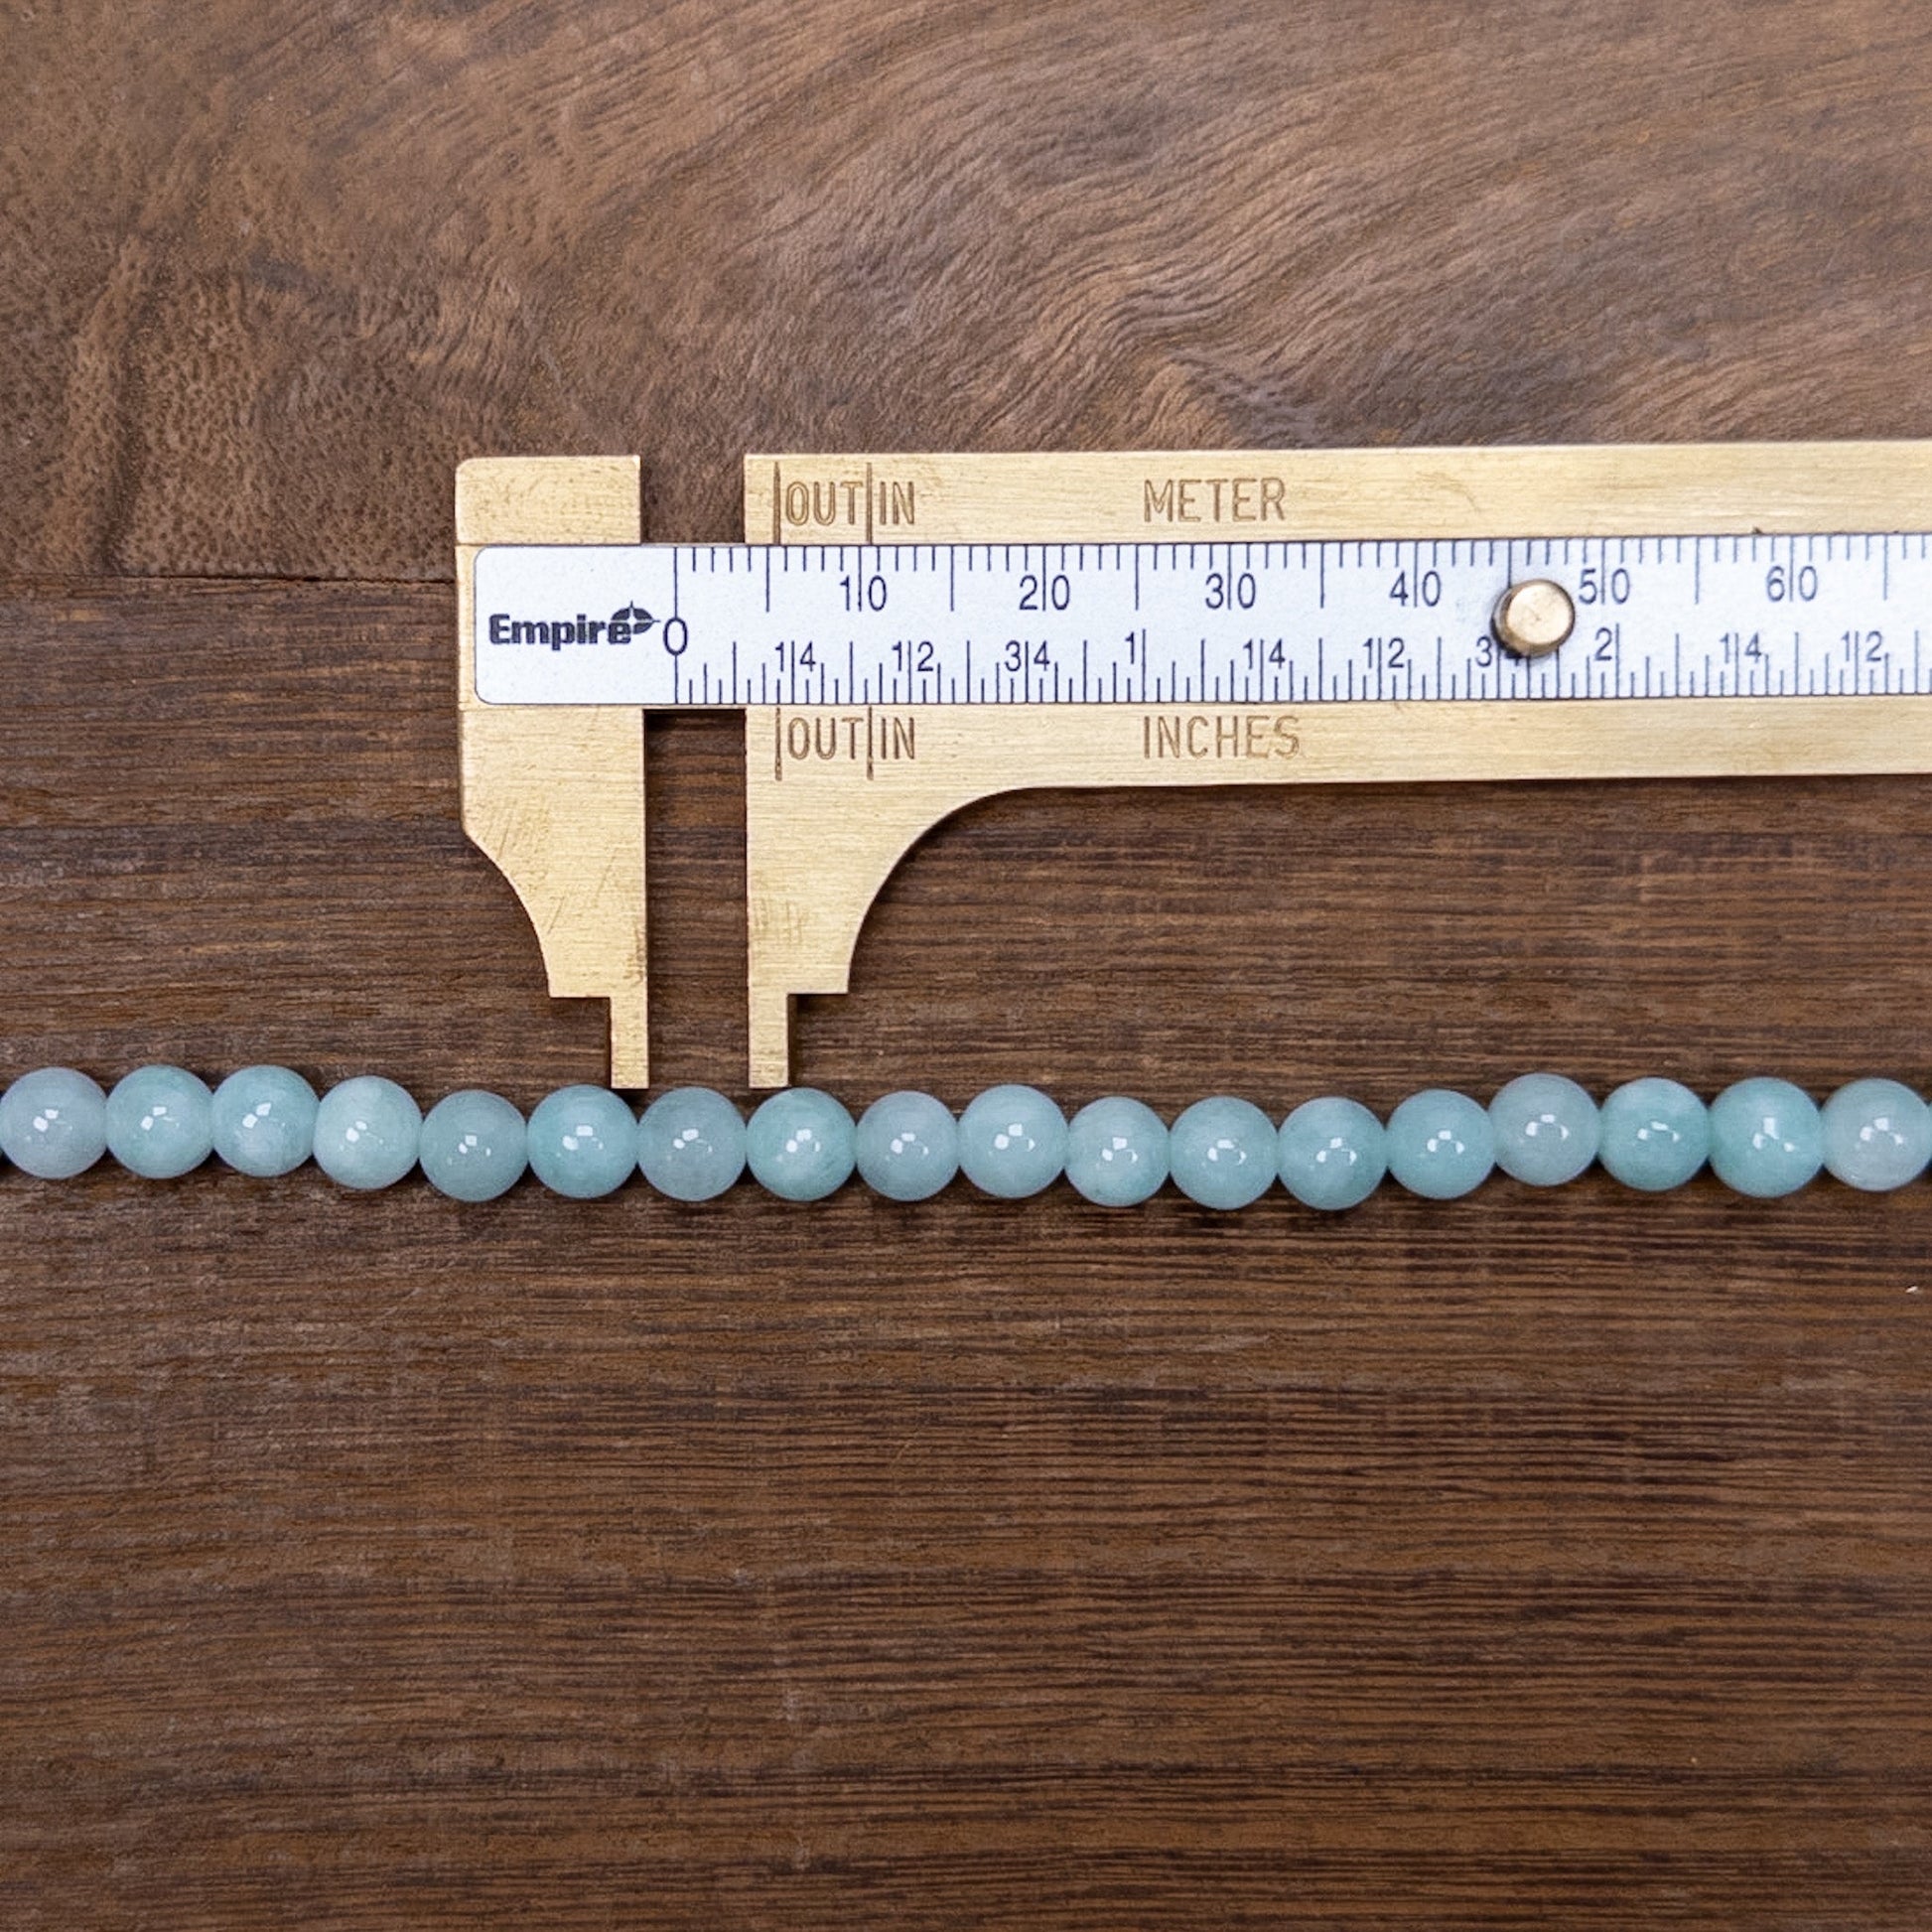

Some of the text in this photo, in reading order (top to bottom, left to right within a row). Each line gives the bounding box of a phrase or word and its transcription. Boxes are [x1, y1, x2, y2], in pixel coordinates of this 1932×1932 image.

[785, 481, 915, 526] OUT IN
[1144, 478, 1287, 523] METER
[488, 613, 633, 651] Empire
[788, 717, 915, 760] OUT IN
[1144, 715, 1301, 759] INCHES
